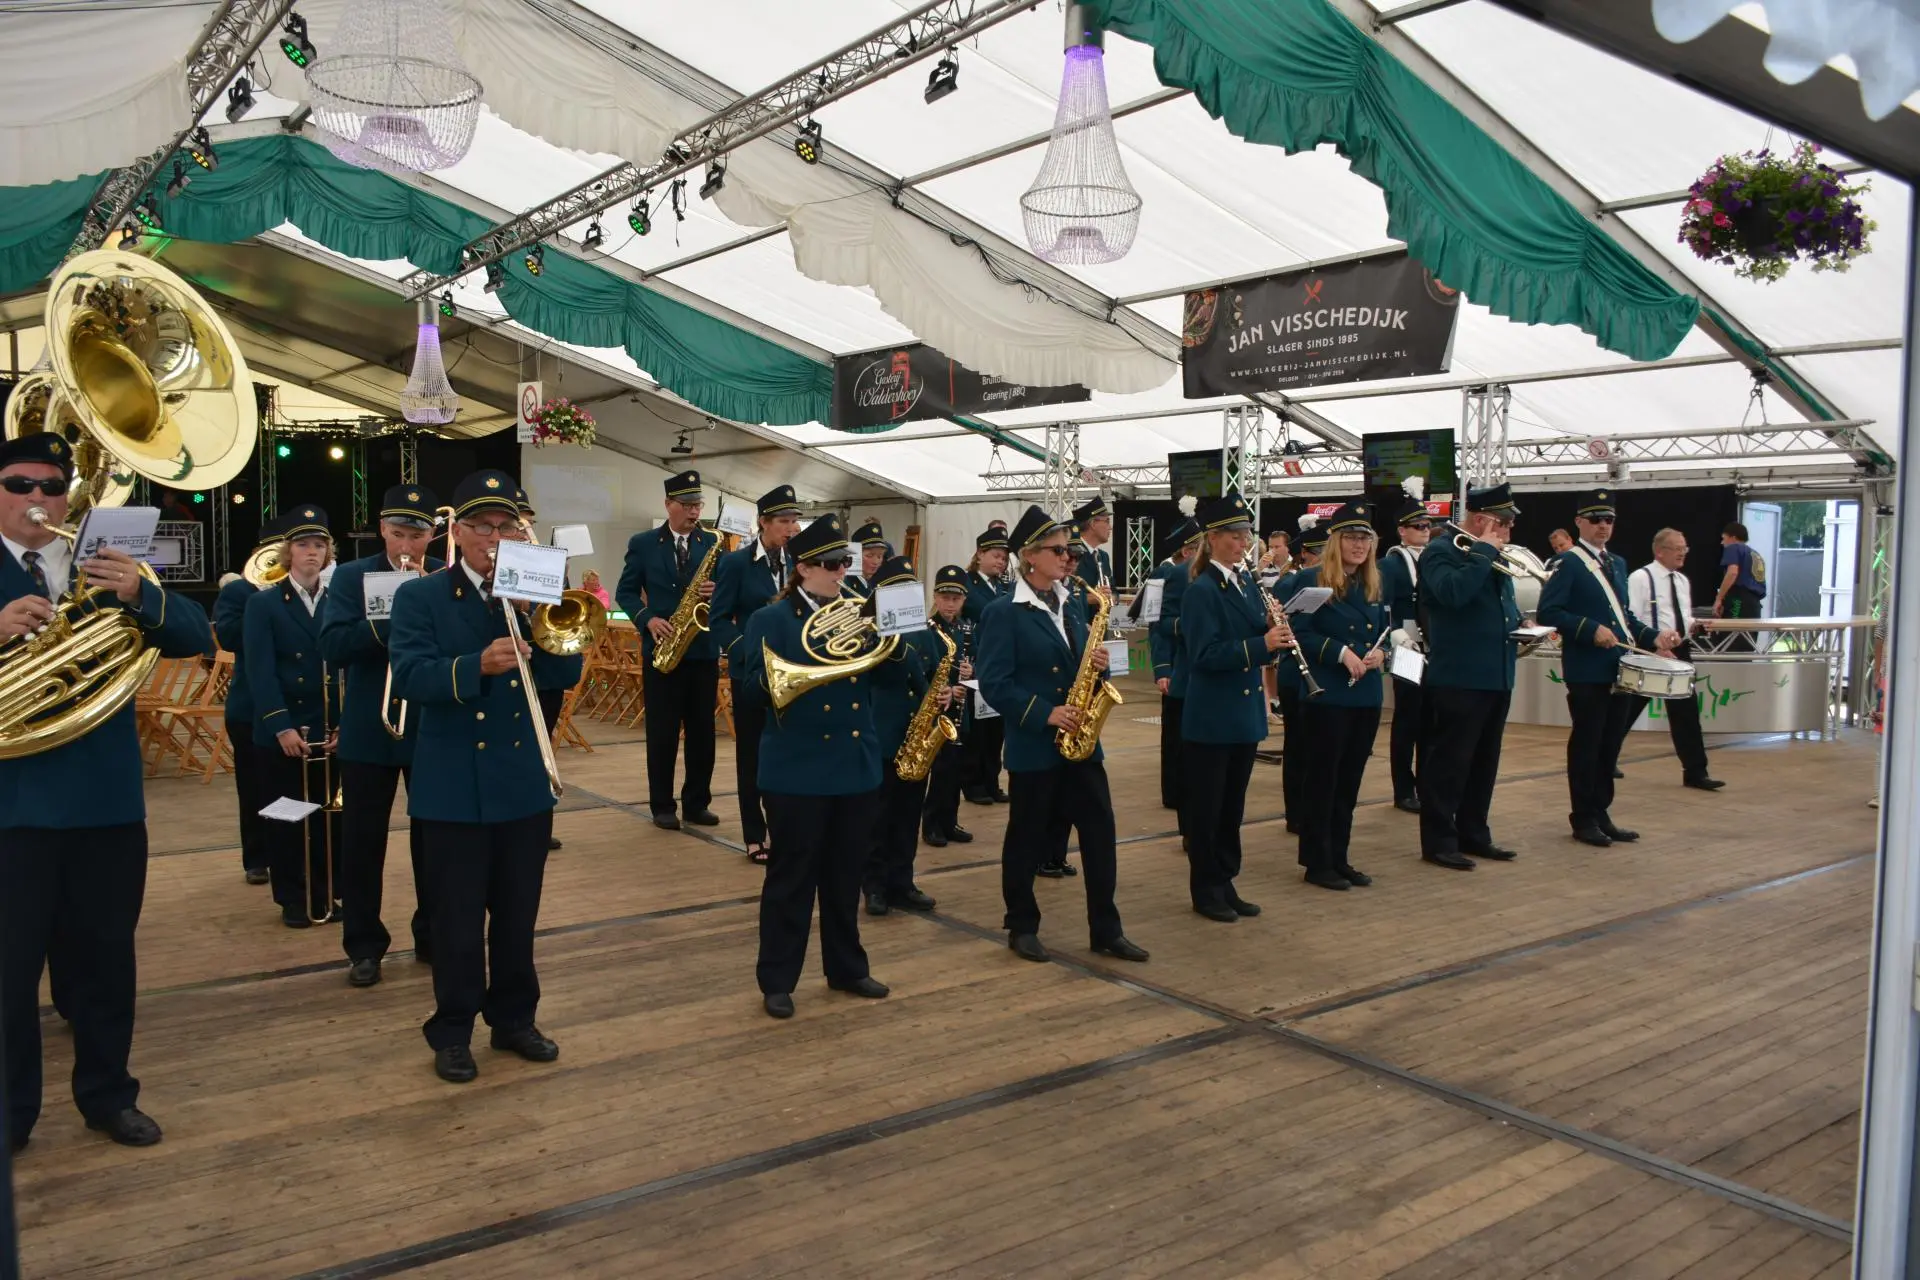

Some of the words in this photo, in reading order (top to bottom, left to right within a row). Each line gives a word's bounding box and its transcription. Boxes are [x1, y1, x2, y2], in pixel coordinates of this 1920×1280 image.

[1228, 323, 1263, 353] JAN
[1270, 306, 1409, 337] VISSCHEDIJK
[1266, 341, 1303, 355] SLAGER
[1306, 337, 1334, 349] SINDS
[1338, 333, 1359, 344] 1985
[1230, 350, 1408, 378] WWW.SLAGERIJ-JANVISSCHEDIJK.NL
[982, 390, 1009, 401] Catering
[1012, 386, 1026, 397] BBQ
[523, 574, 559, 584] AMICITIA
